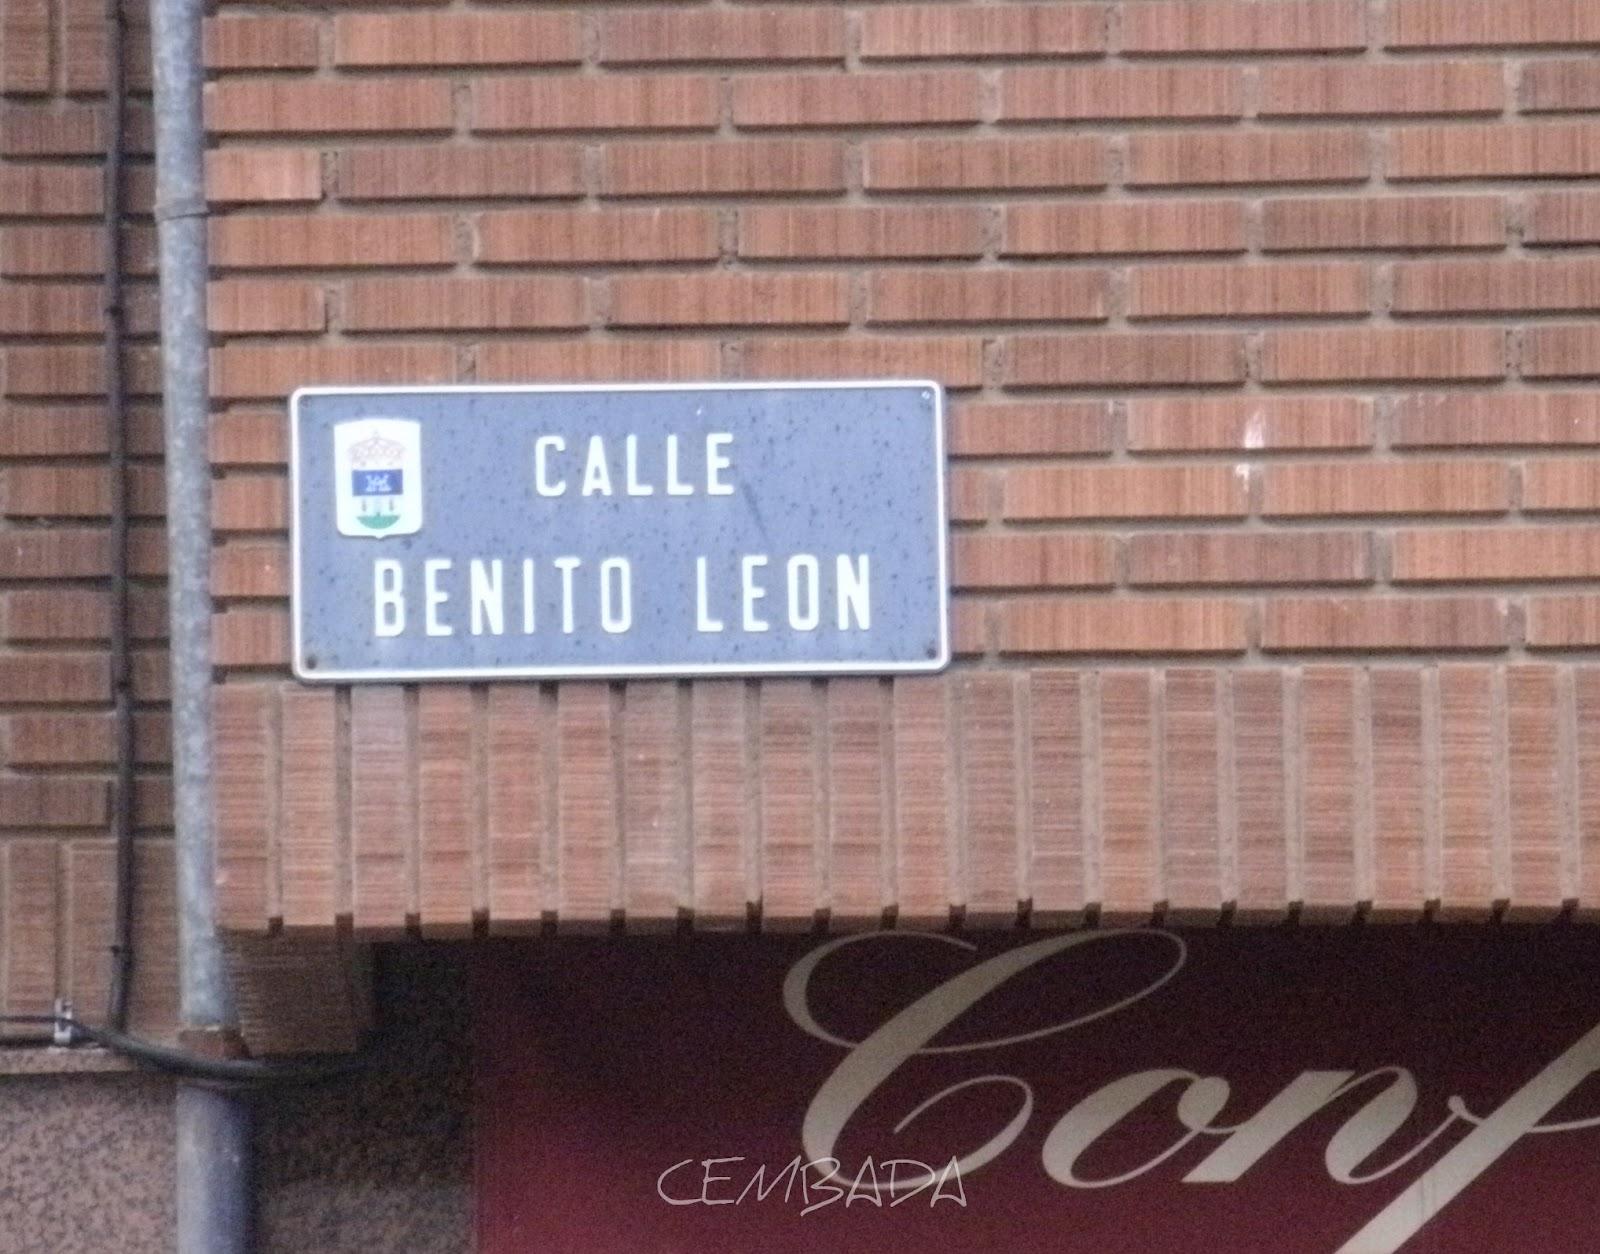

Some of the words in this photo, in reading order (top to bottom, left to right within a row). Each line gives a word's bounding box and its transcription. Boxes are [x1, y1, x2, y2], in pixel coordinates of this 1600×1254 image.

[535, 432, 735, 497] CALLE
[374, 556, 632, 637] BENITO
[695, 554, 871, 632] LEON
